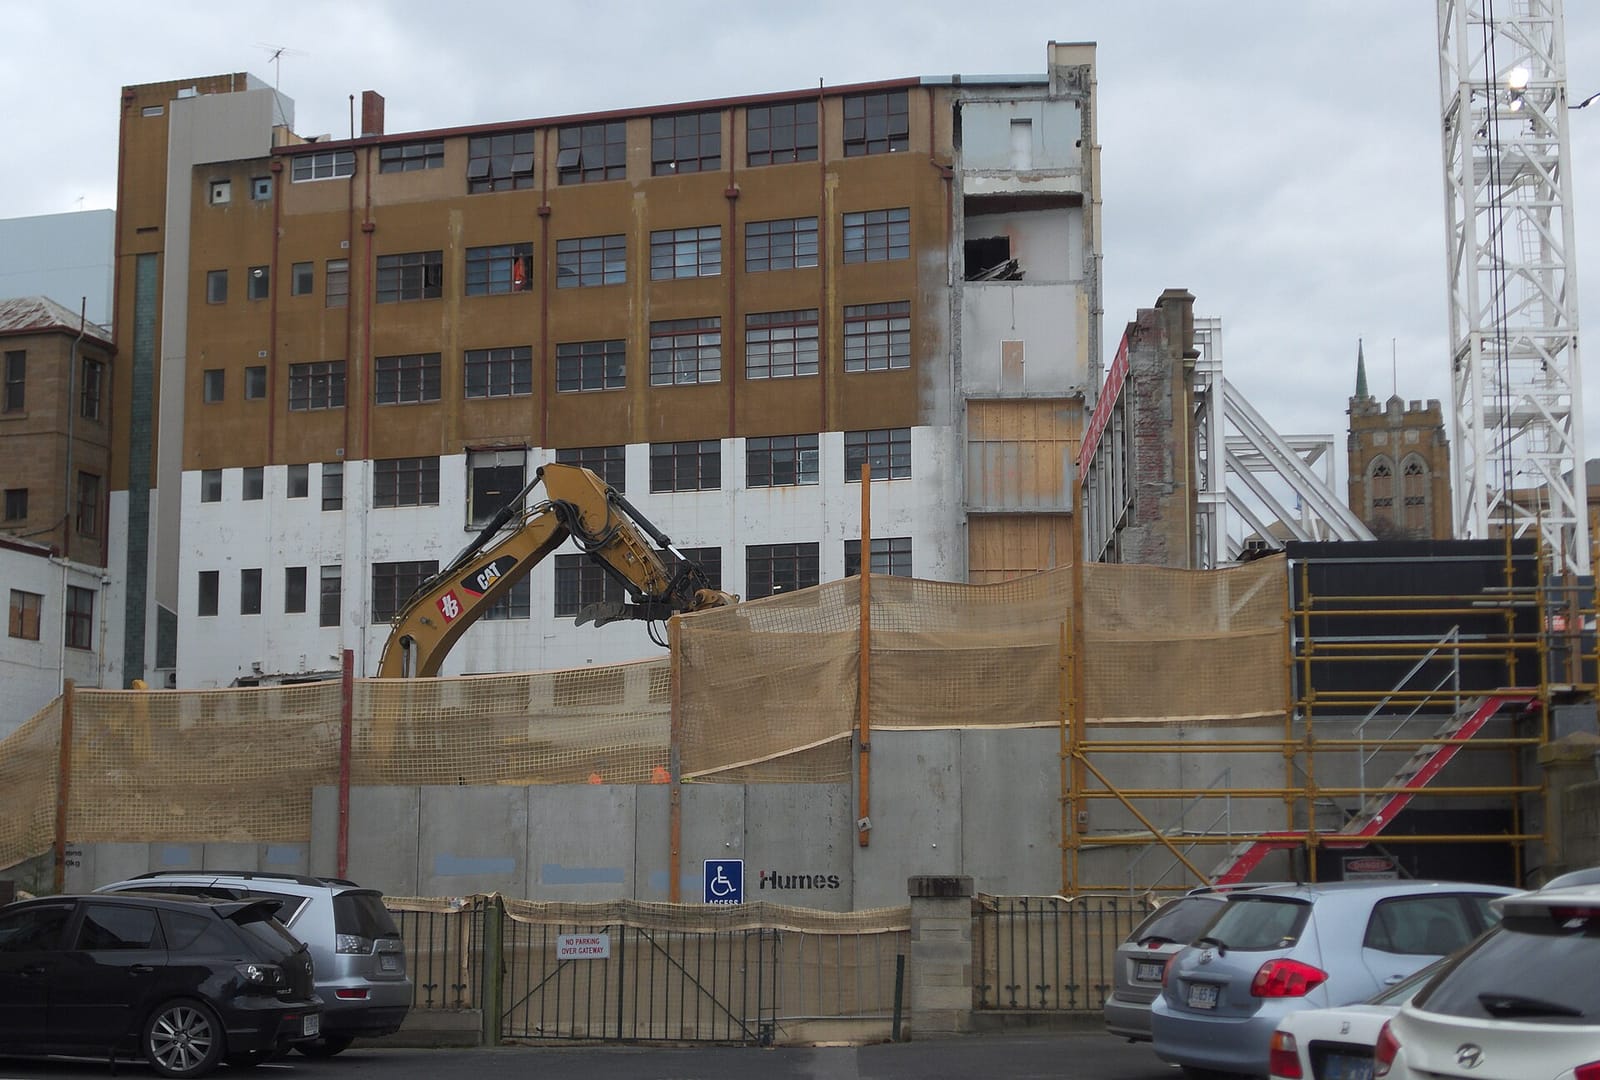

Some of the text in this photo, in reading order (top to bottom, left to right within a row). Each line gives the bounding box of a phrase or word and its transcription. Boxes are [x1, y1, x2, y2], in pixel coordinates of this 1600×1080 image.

[477, 562, 501, 590] CAT
[760, 870, 840, 889] Humes
[576, 938, 600, 946] PARKING
